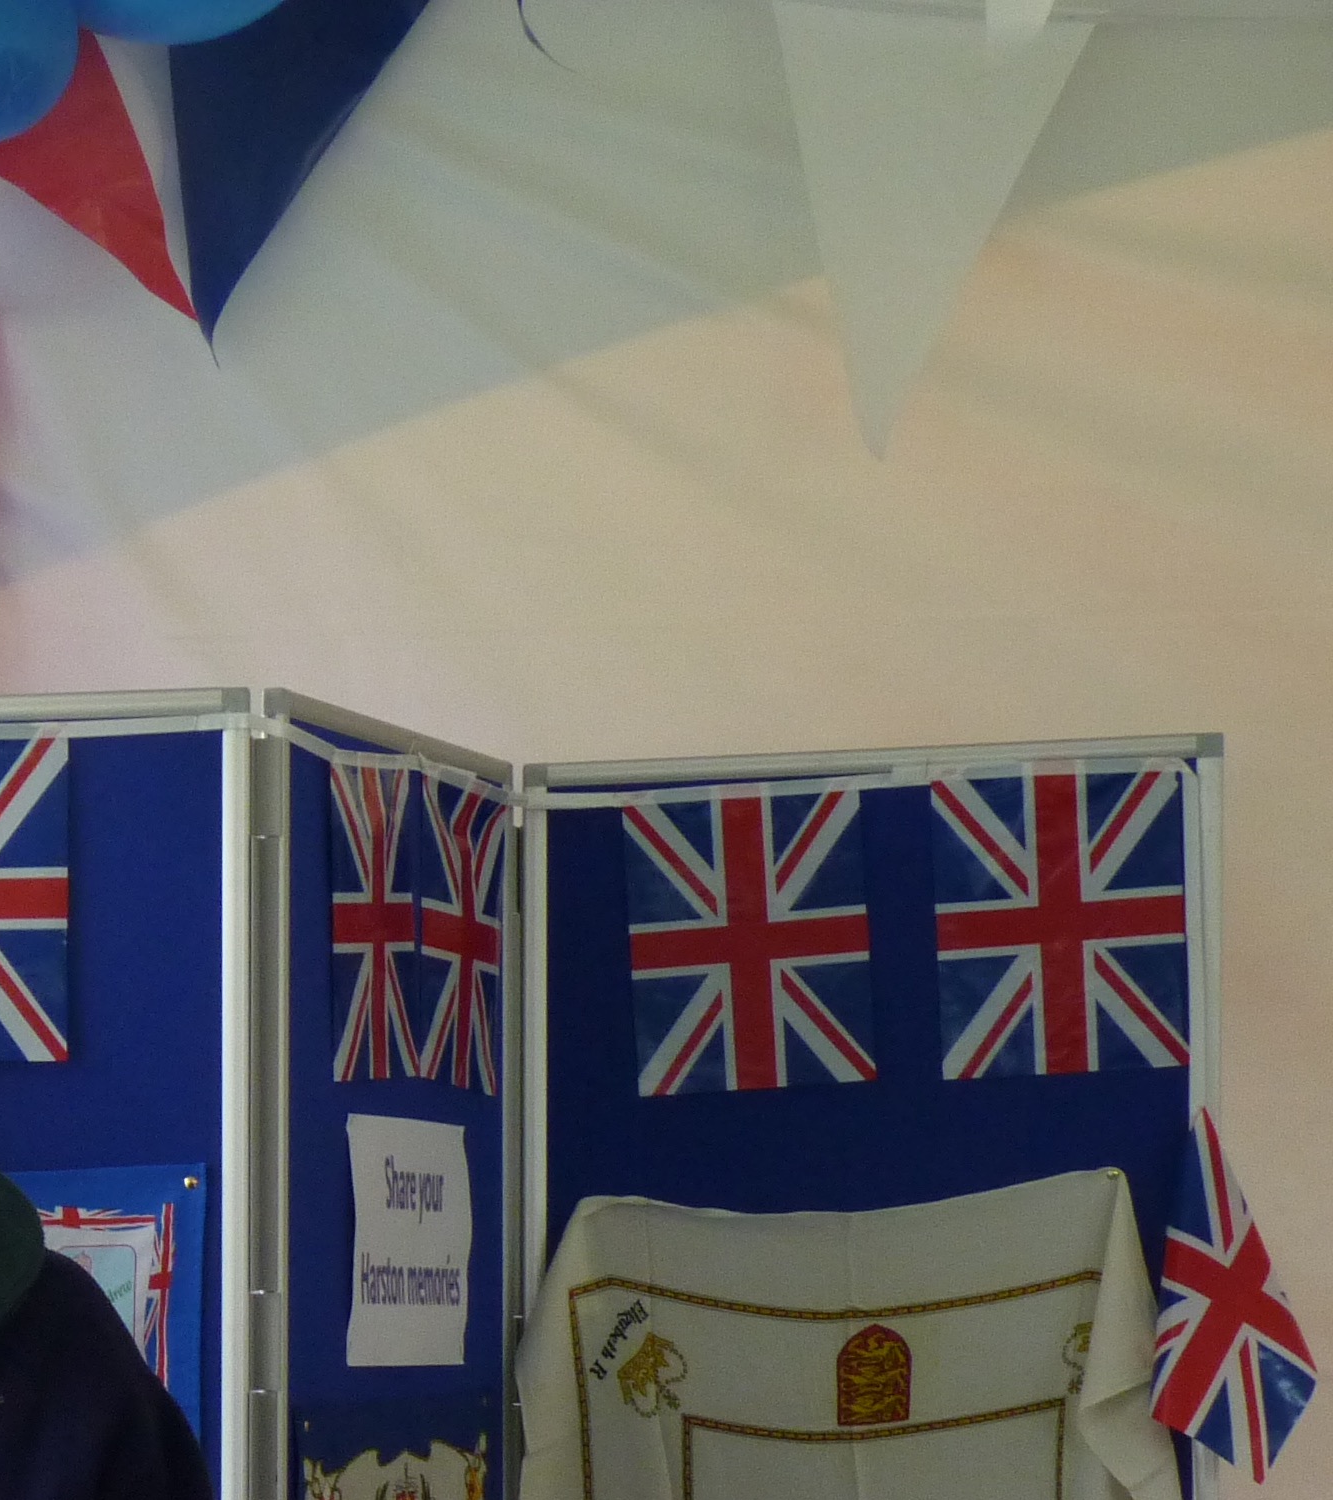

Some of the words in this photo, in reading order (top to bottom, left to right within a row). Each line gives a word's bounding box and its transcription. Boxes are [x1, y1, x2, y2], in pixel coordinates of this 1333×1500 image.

[384, 1154, 416, 1211] Share
[419, 1172, 444, 1224] your
[361, 1252, 404, 1305] Harston
[408, 1254, 461, 1307] memories
